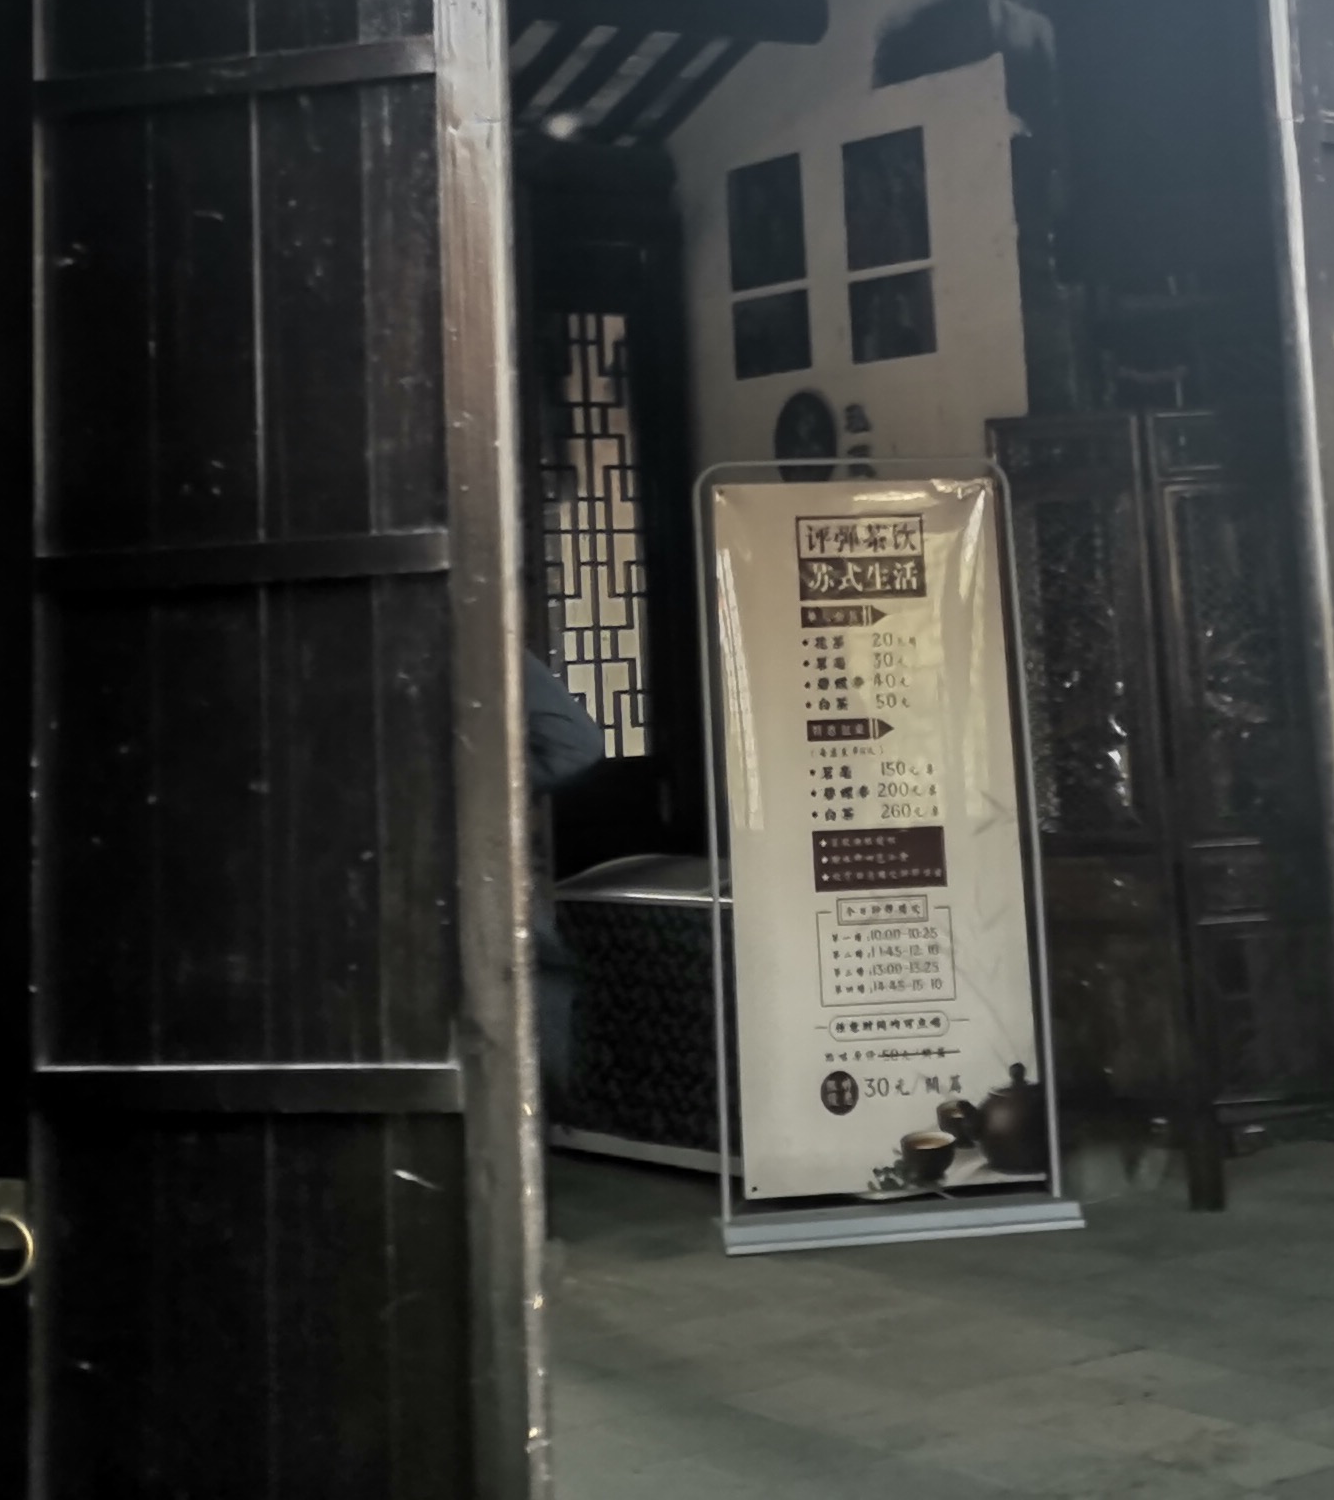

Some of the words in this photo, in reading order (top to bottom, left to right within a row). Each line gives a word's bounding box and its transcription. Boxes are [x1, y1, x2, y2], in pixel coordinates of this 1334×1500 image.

[806, 522, 917, 554] 评弹茶饮
[808, 560, 918, 593] 苏式生活
